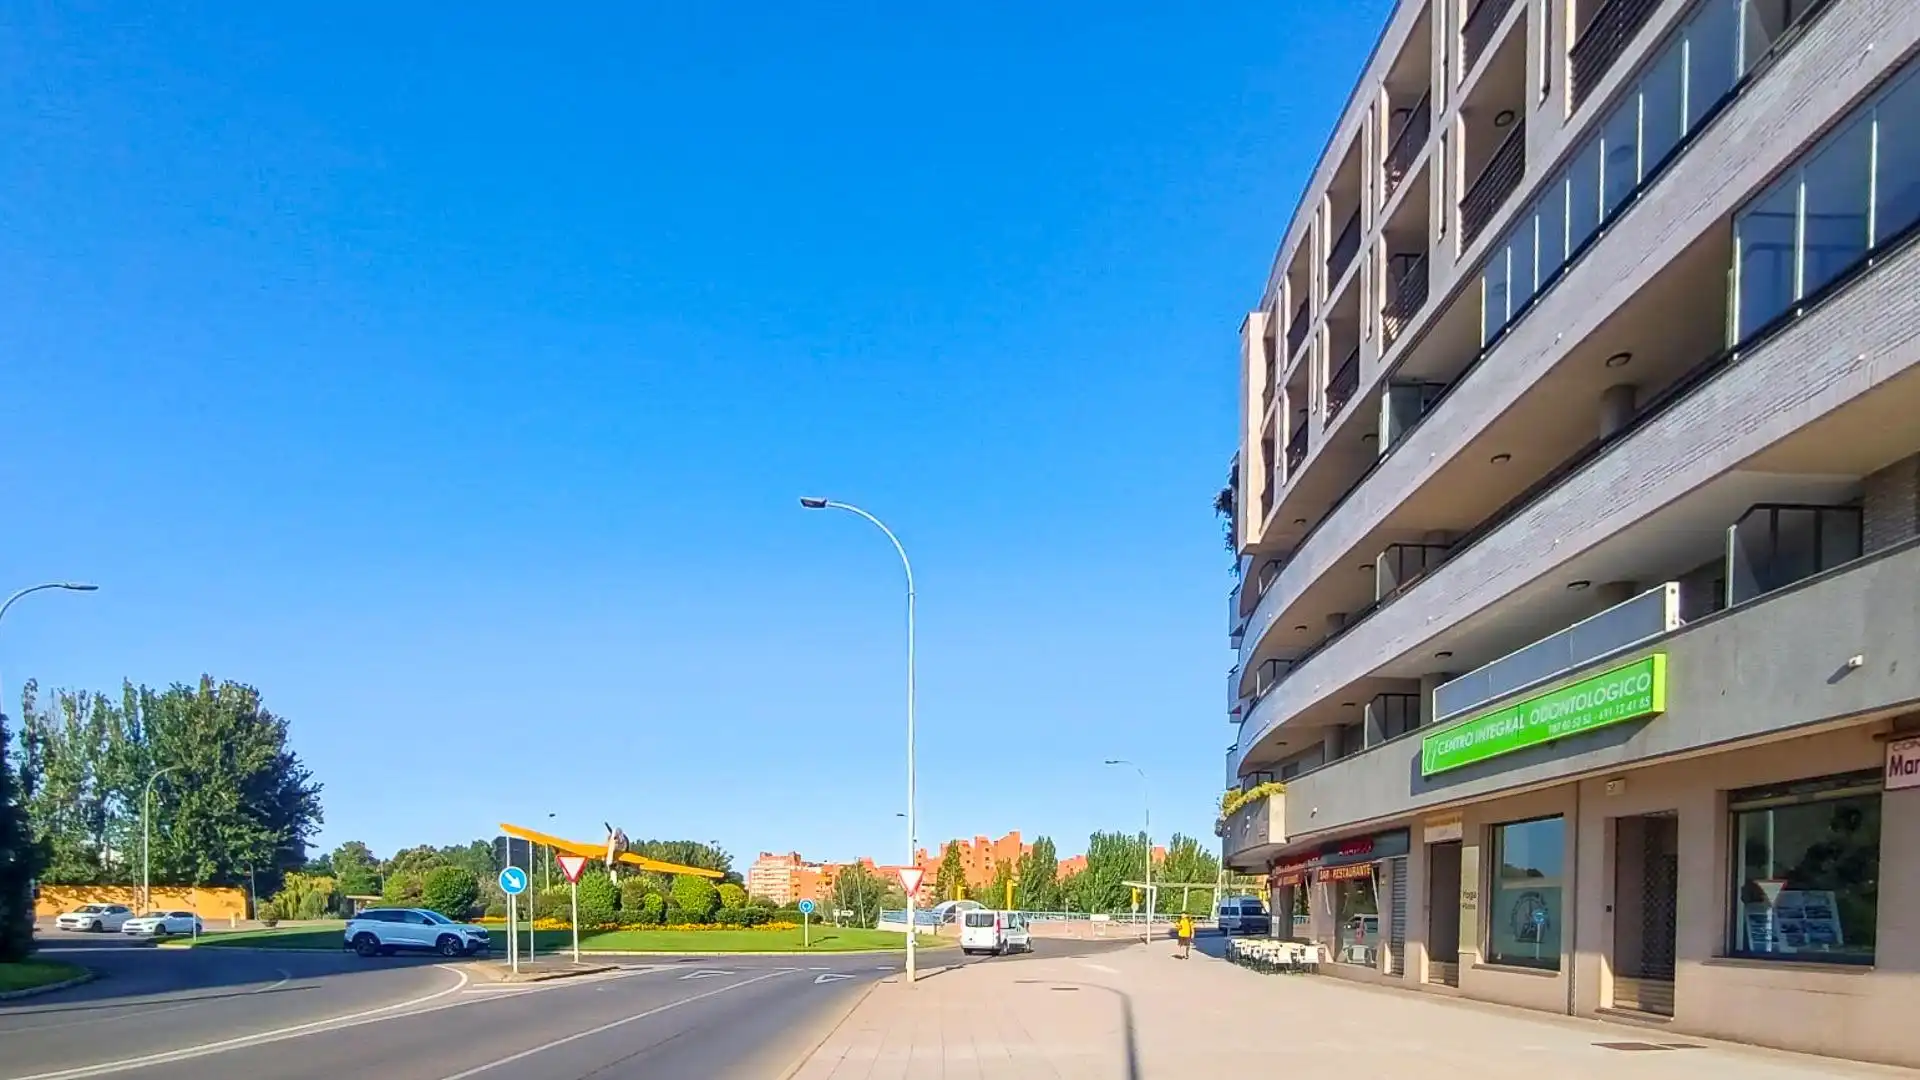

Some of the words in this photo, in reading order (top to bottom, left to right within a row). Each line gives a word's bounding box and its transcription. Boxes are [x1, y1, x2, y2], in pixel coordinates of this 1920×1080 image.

[1437, 731, 1473, 756] CENTRO
[1474, 714, 1525, 744] INTEGRAL
[1332, 863, 1371, 879] RESTAURANTE
